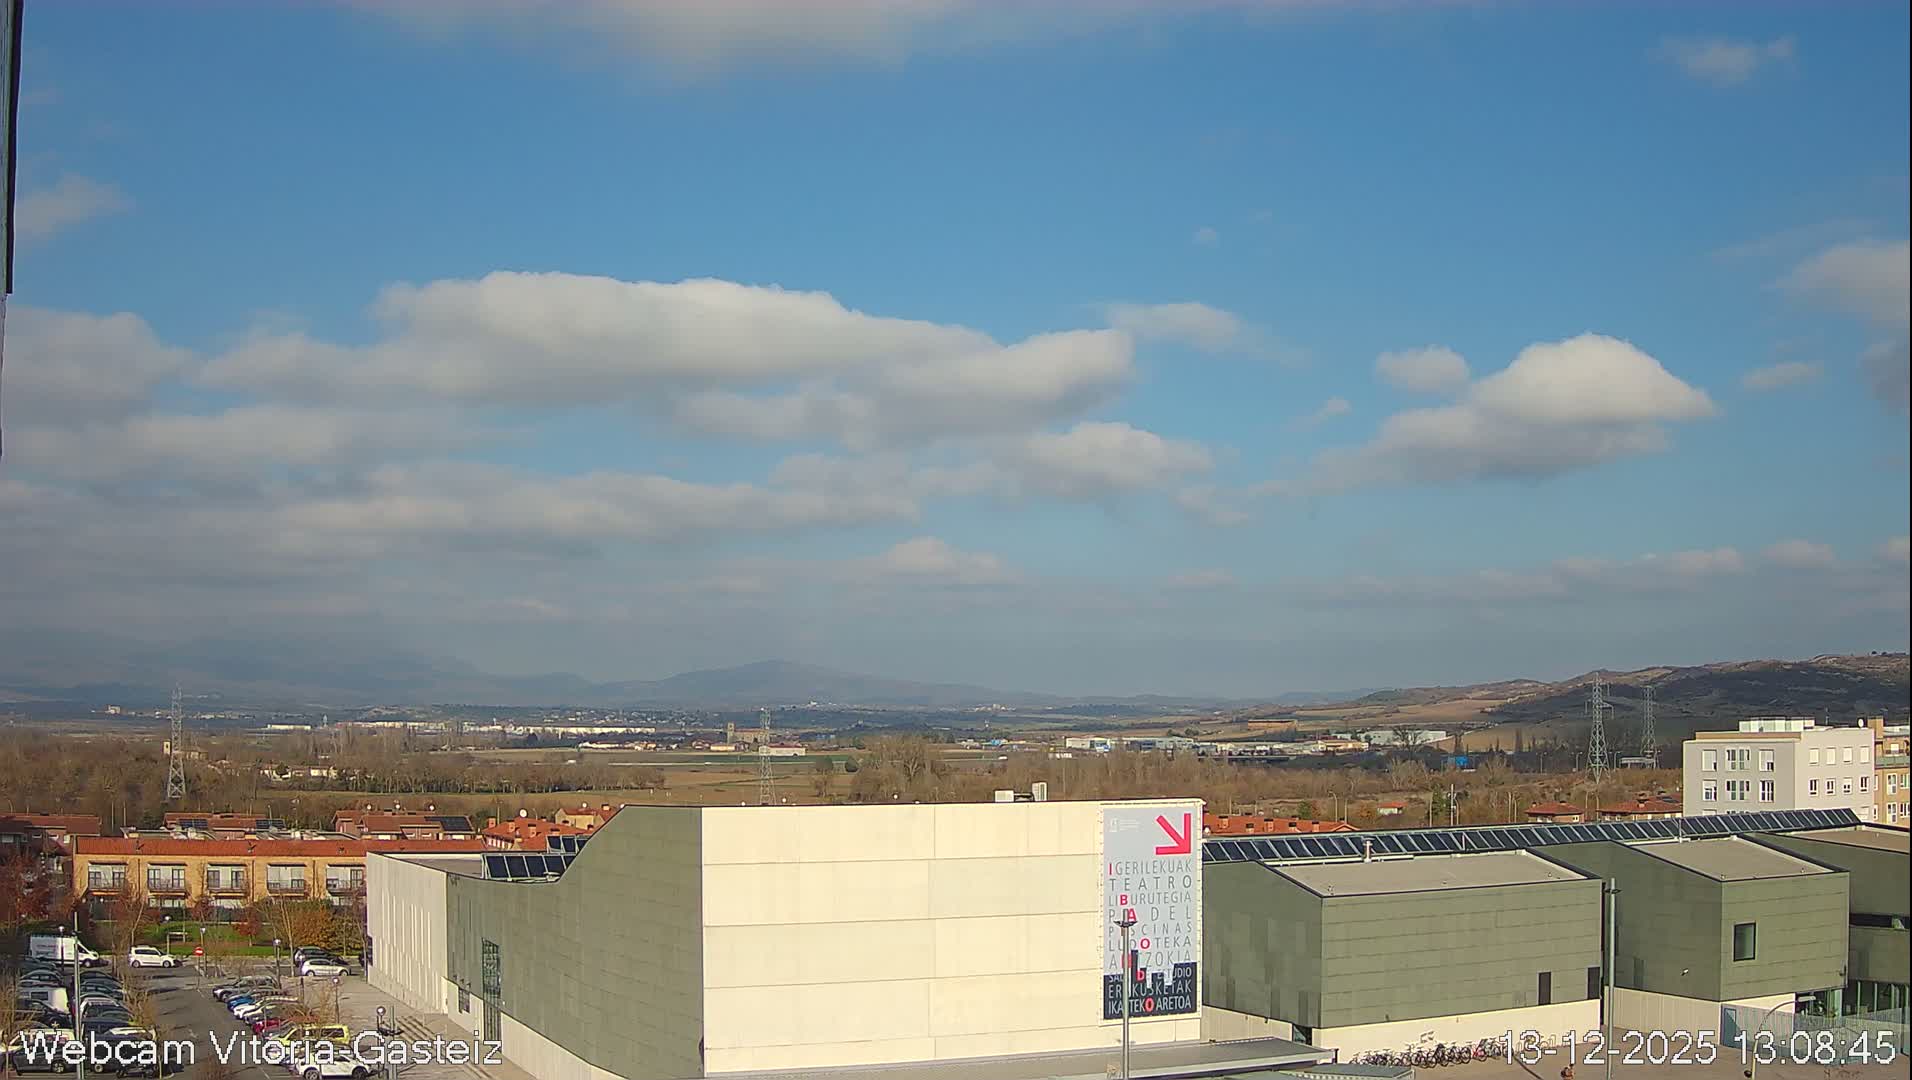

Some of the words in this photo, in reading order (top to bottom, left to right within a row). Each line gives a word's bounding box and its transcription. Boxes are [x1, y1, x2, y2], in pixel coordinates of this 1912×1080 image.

[1108, 859, 1192, 876] IGERILEKUAK
[1108, 874, 1192, 892] TEATRO
[1108, 890, 1192, 907] LIBURUTEGIA
[1108, 921, 1192, 937] PSCINAS
[1108, 950, 1192, 970] AZOKIA
[1108, 979, 1192, 998] ERKUSKETAK
[1108, 996, 1155, 1015] IKATEKO
[1156, 995, 1192, 1010] ARETOA
